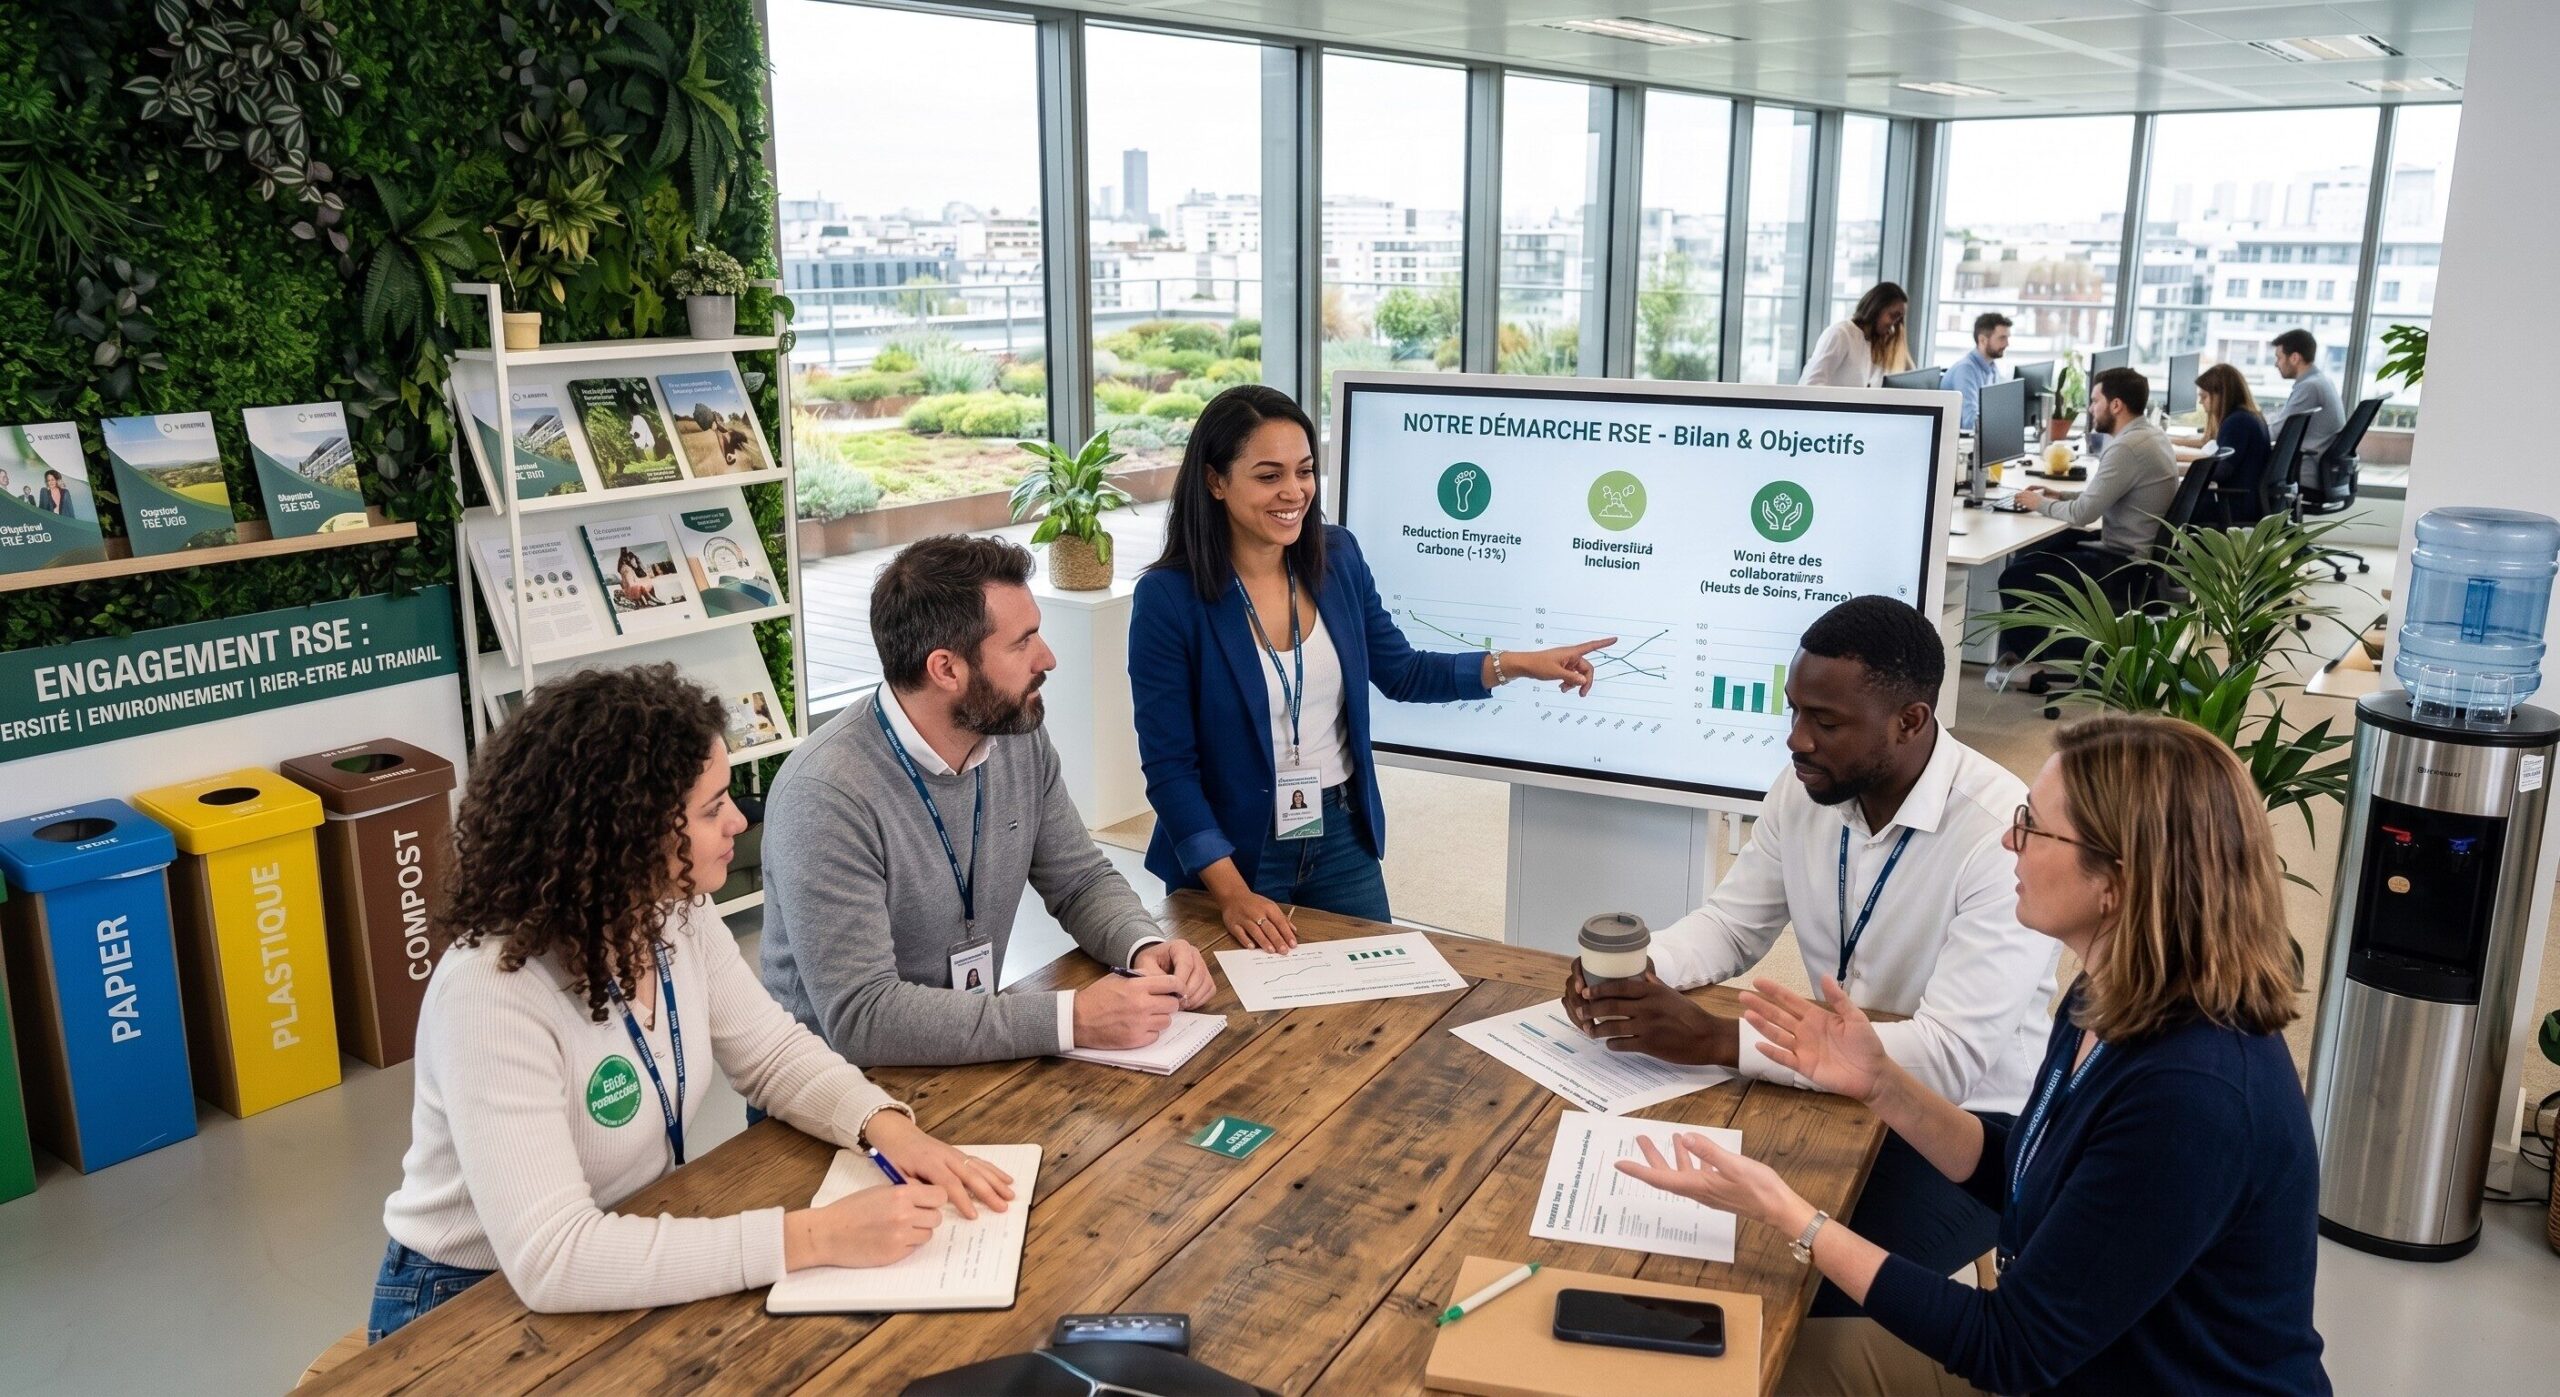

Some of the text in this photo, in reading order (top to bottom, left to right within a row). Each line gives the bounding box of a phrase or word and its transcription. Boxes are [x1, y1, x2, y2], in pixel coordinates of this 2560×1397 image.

[1403, 412, 1474, 435] NOTRE
[1479, 412, 1602, 442] DÉMARCHE
[1608, 422, 1652, 444] RSE
[1673, 425, 1730, 448] Bilan
[1737, 428, 1753, 450] &
[1760, 429, 1865, 457] Objectifs
[1402, 525, 1459, 541] Reduction
[1416, 542, 1506, 563] Carbone (-13%)
[1769, 551, 1795, 565] être
[1798, 554, 1822, 567] des
[1584, 555, 1640, 570] Inclusion
[1744, 583, 1760, 596] de
[1762, 585, 1801, 601] Soins,
[1696, 622, 1708, 630] 120
[1695, 638, 1707, 646] 100
[34, 618, 370, 703] ENGAGEMENT RSE :
[1696, 654, 1706, 662] 80
[1695, 670, 1705, 678] 60
[88, 680, 245, 726] ENVIRONNEMENT
[259, 661, 348, 694] RIER-ETRE
[351, 657, 373, 677] AU
[1694, 686, 1704, 694] 40
[394, 829, 432, 981] COMPOST
[251, 862, 301, 1050] PLASTIQUE
[97, 914, 142, 1043] PAPIER
